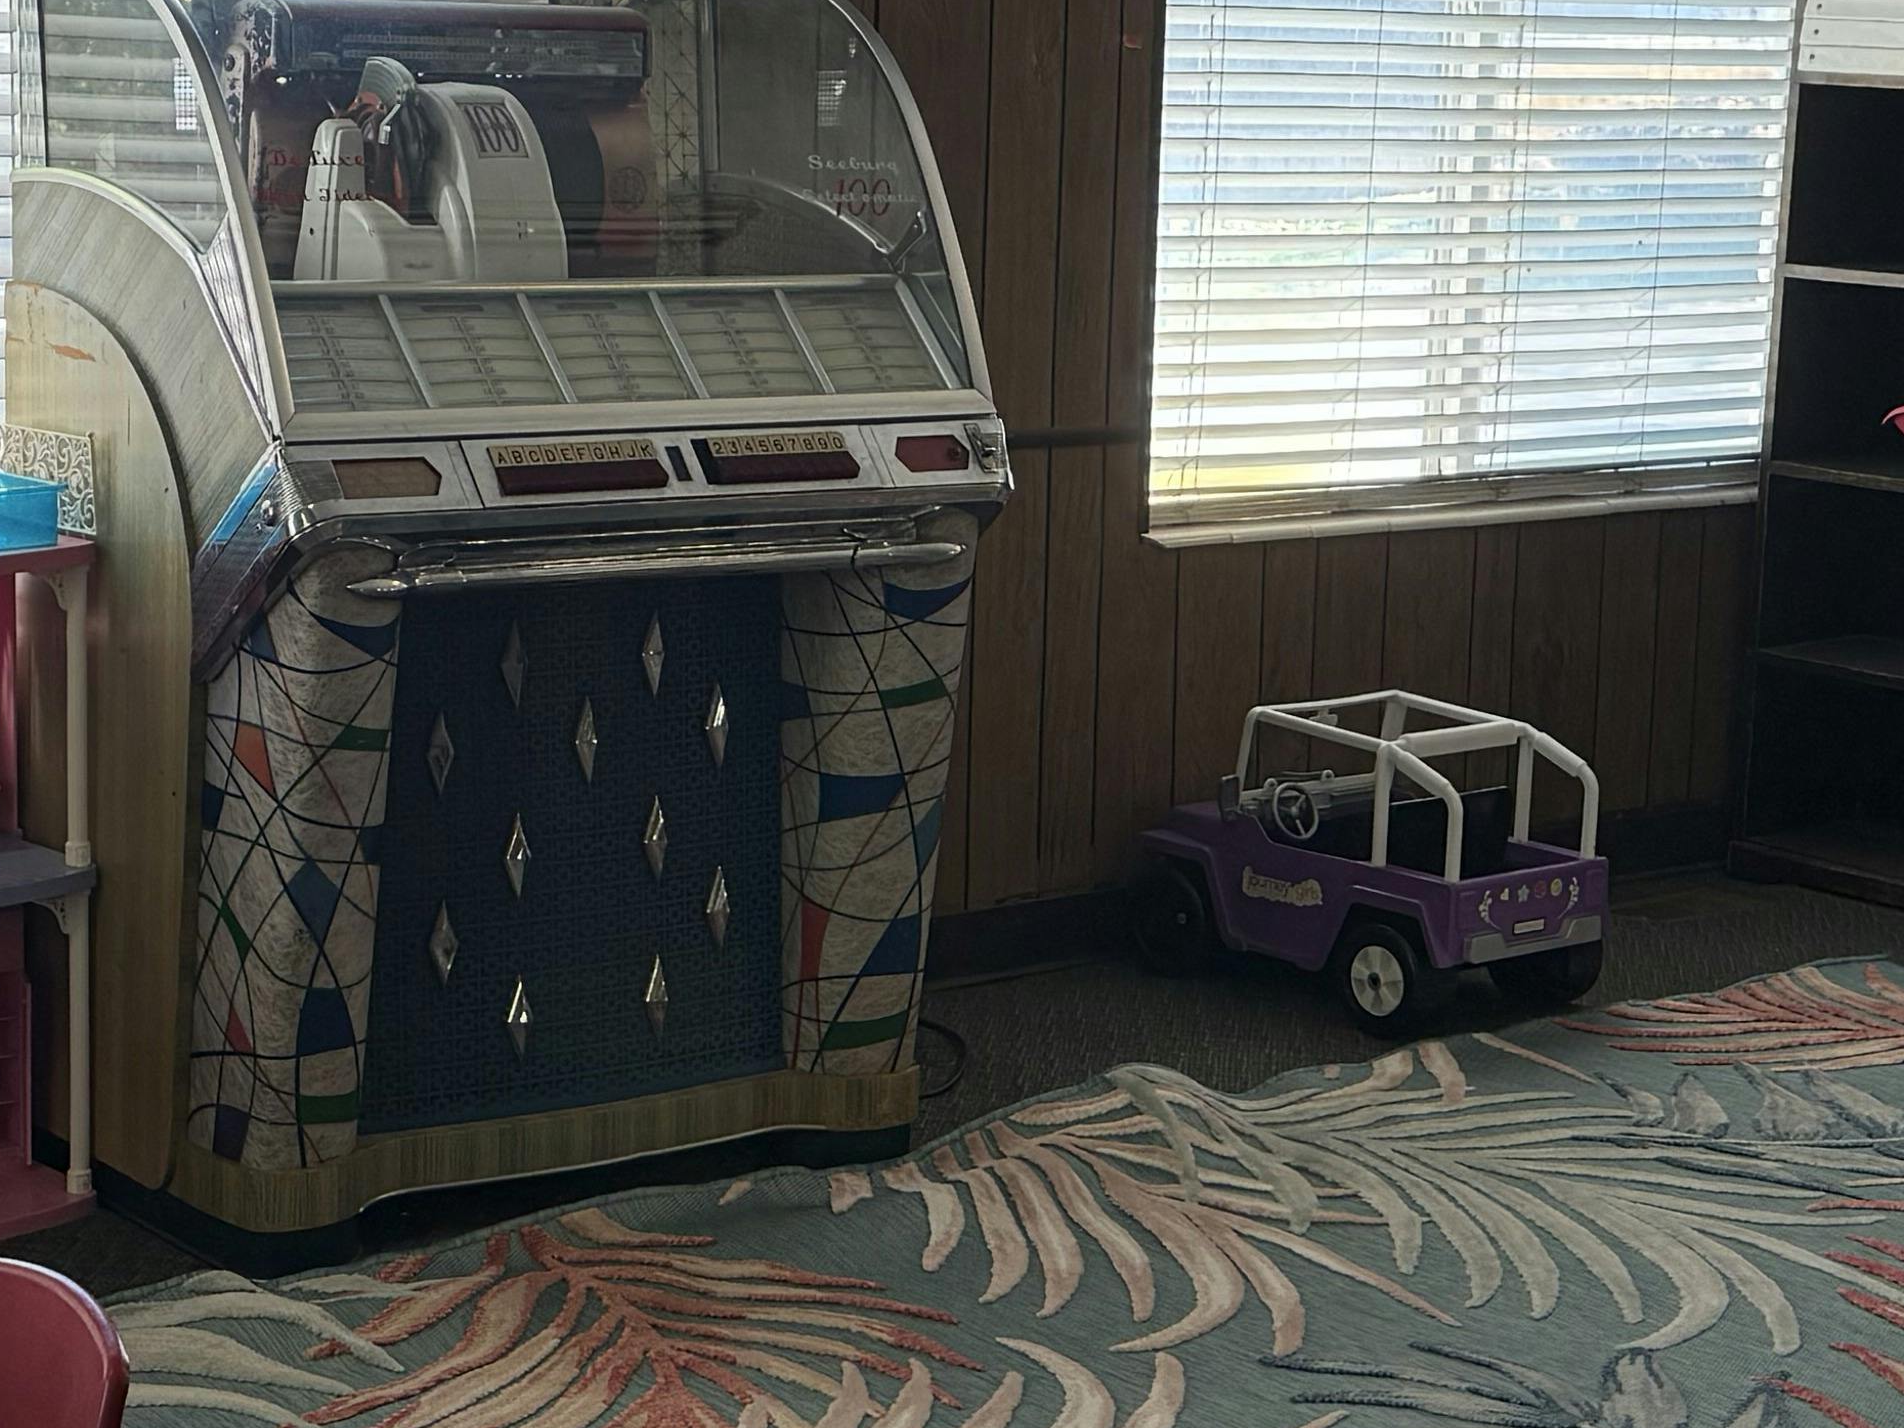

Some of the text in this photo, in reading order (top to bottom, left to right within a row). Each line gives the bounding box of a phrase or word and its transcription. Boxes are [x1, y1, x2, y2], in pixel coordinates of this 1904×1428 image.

[463, 104, 520, 153] 100
[807, 154, 899, 176] Seeburg
[834, 178, 891, 217] 100
